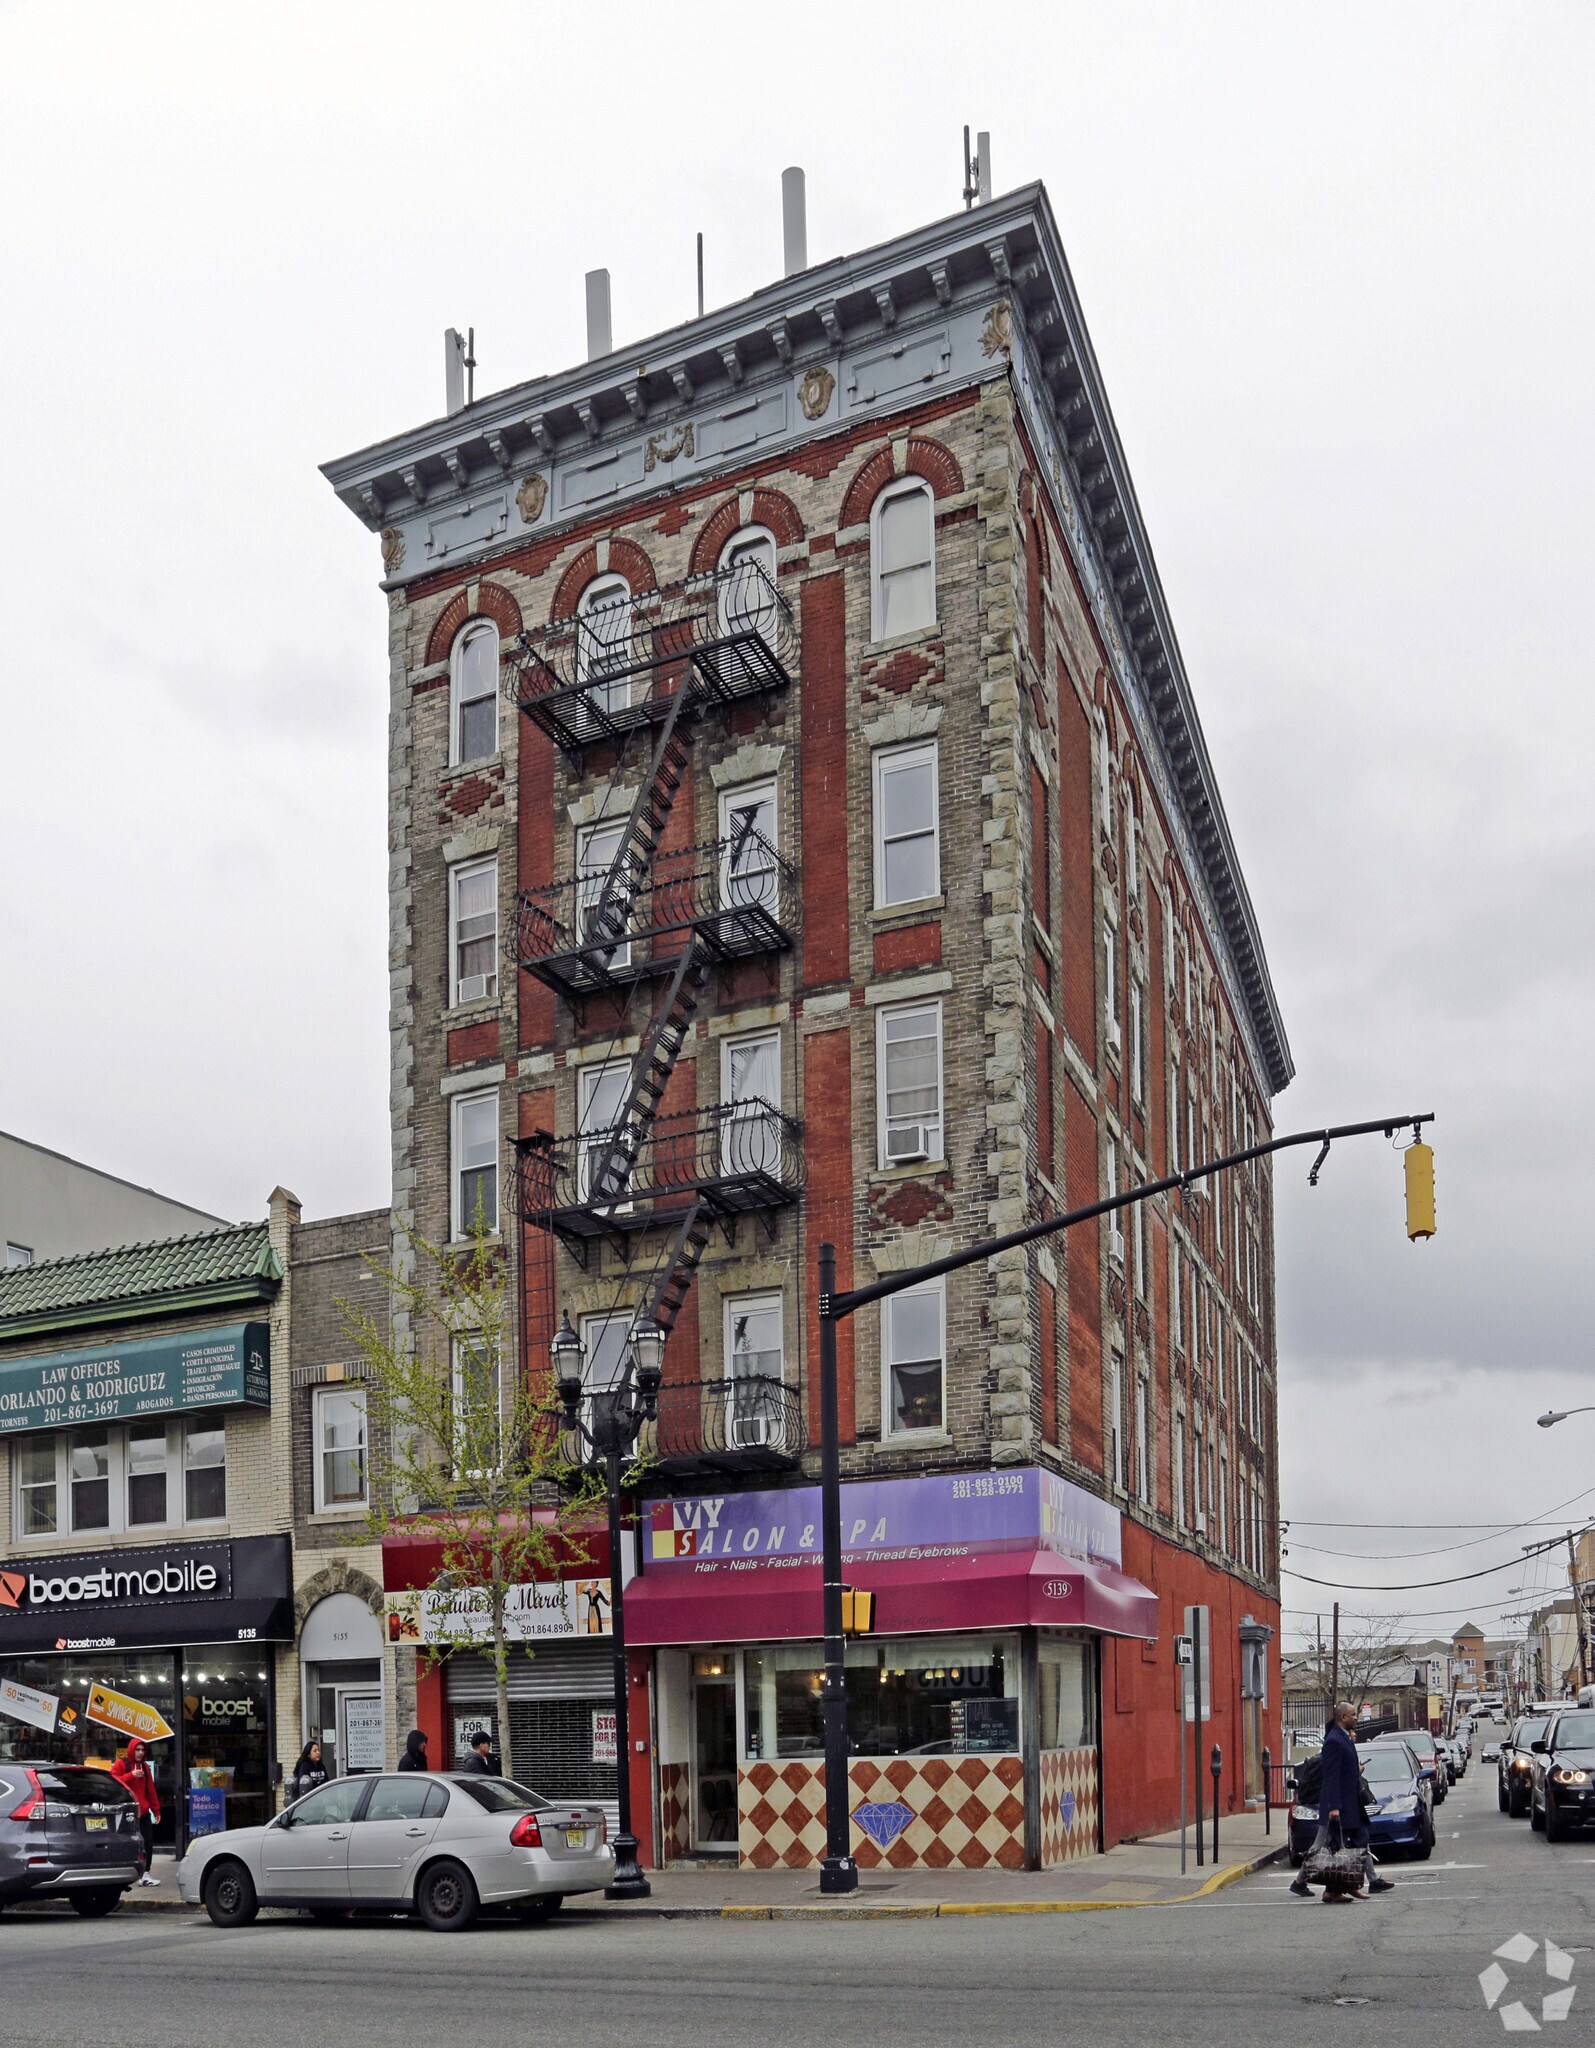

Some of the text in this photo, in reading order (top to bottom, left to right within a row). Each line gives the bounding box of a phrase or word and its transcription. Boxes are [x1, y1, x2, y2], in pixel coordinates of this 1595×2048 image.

[186, 1345, 236, 1358] CASOS CRIMINALES
[186, 1354, 234, 1367] CORTE MUNICIPAL
[42, 1360, 120, 1385] LAW OFFICES
[0, 1372, 166, 1411] ORLANDO & RODRIGUEZ
[186, 1384, 216, 1394] DIVORCIOS
[205, 1389, 238, 1400] PERSONALES
[136, 1397, 174, 1411] ABOGADOS
[44, 1400, 119, 1423] 201-867-3697
[0, 1416, 29, 1428] TORNEYS
[952, 1475, 1024, 1489] 201-863-0100
[952, 1485, 1025, 1499] 201-328-6771
[674, 1499, 724, 1529] VY
[679, 1517, 887, 1555] SALON & PA
[695, 1561, 718, 1573] Hair
[730, 1560, 758, 1571] Nails
[767, 1555, 803, 1568] Facial
[865, 1548, 906, 1561] Thread
[909, 1545, 969, 1561] Eyebrows
[1047, 1583, 1068, 1597] 5139
[237, 1628, 257, 1639] 5135
[7, 1687, 17, 1699] 50
[42, 1700, 53, 1713] 50
[202, 1696, 254, 1716] boost
[107, 1701, 160, 1735] SAVINGS INSIDE
[202, 1716, 231, 1726] mobile
[597, 1717, 616, 1730] STO
[58, 1719, 77, 1733] boost
[463, 1722, 482, 1731] FOR
[460, 1732, 473, 1743] RE
[192, 1794, 211, 1802] Todo
[192, 1802, 220, 1811] México
